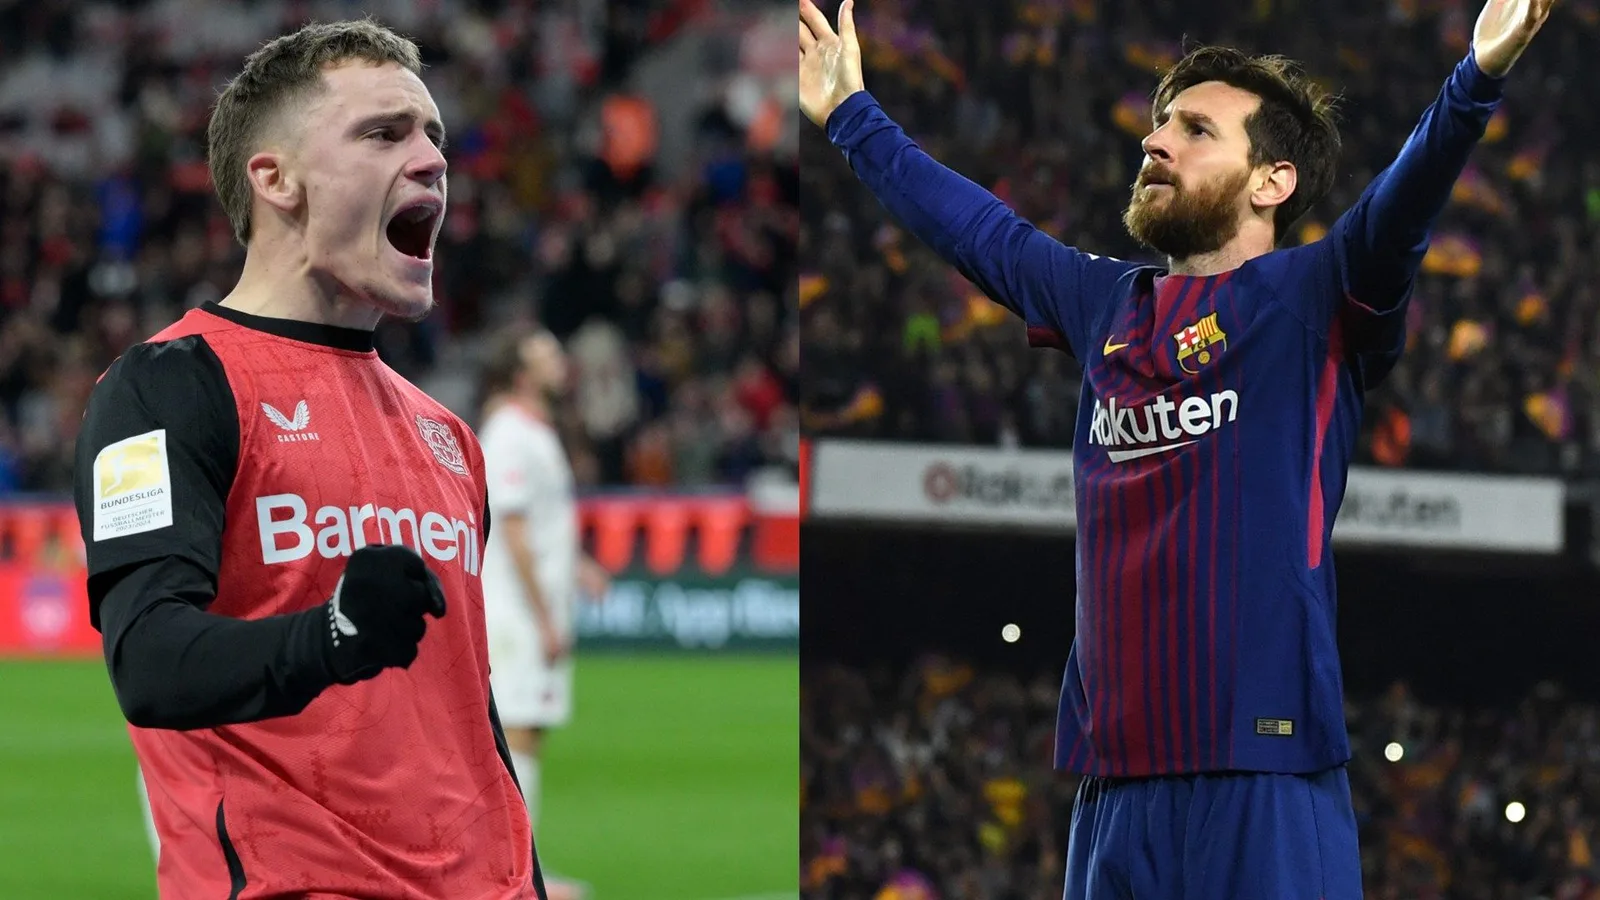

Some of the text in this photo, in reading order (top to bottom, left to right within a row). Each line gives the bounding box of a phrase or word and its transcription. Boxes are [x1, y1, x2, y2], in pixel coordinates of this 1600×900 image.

[277, 432, 320, 443] CASTORE
[1089, 390, 1239, 446] Rakuten
[100, 487, 164, 510] BUNDESLIGA
[255, 493, 480, 577] Barmeni
